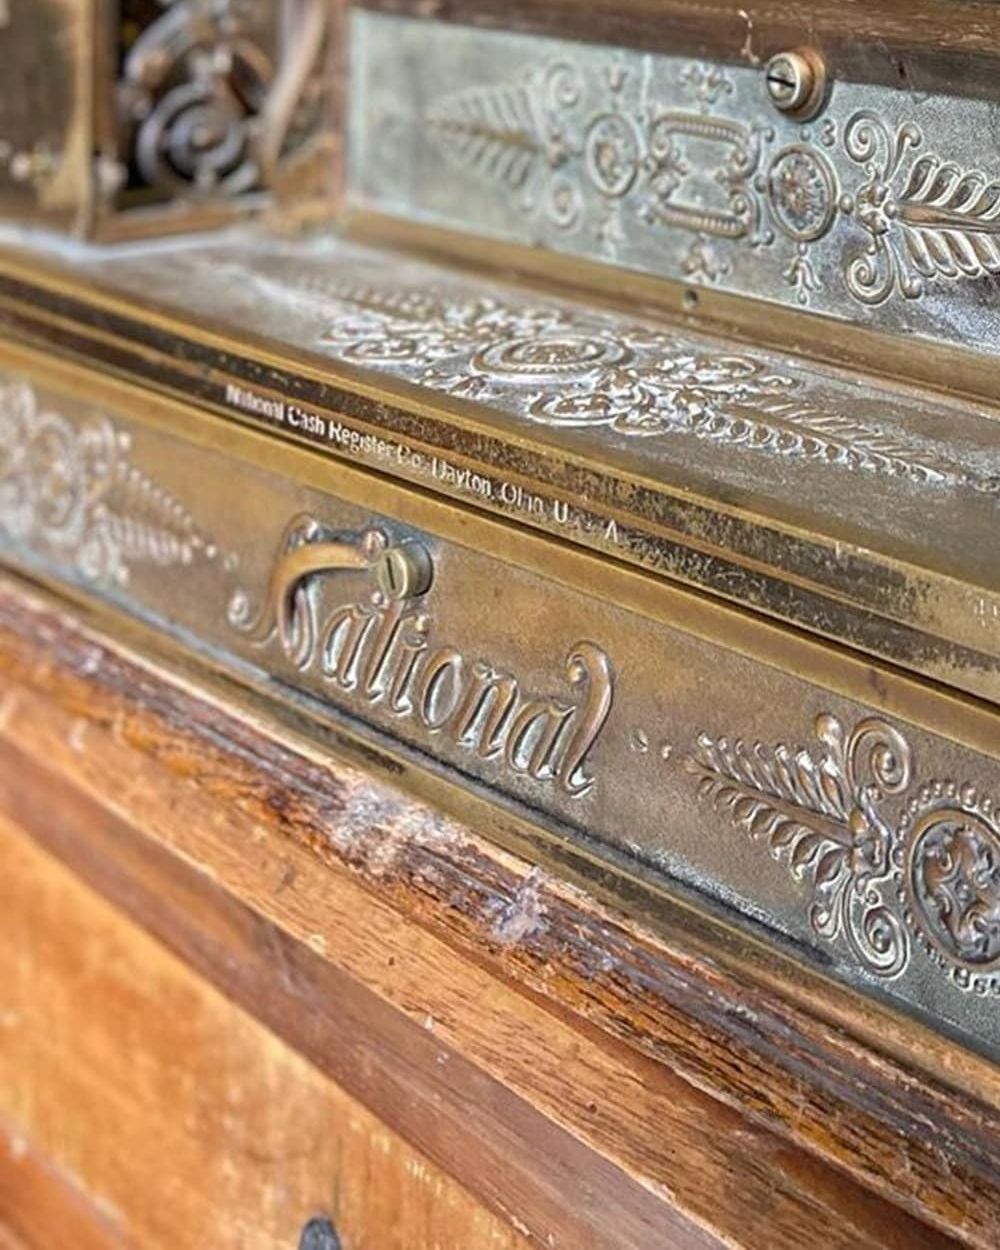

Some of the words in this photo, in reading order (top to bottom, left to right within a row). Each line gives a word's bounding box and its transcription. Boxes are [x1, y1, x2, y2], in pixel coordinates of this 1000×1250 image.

[288, 405, 325, 435] Cash
[329, 420, 394, 458] Register
[227, 513, 615, 798] National
